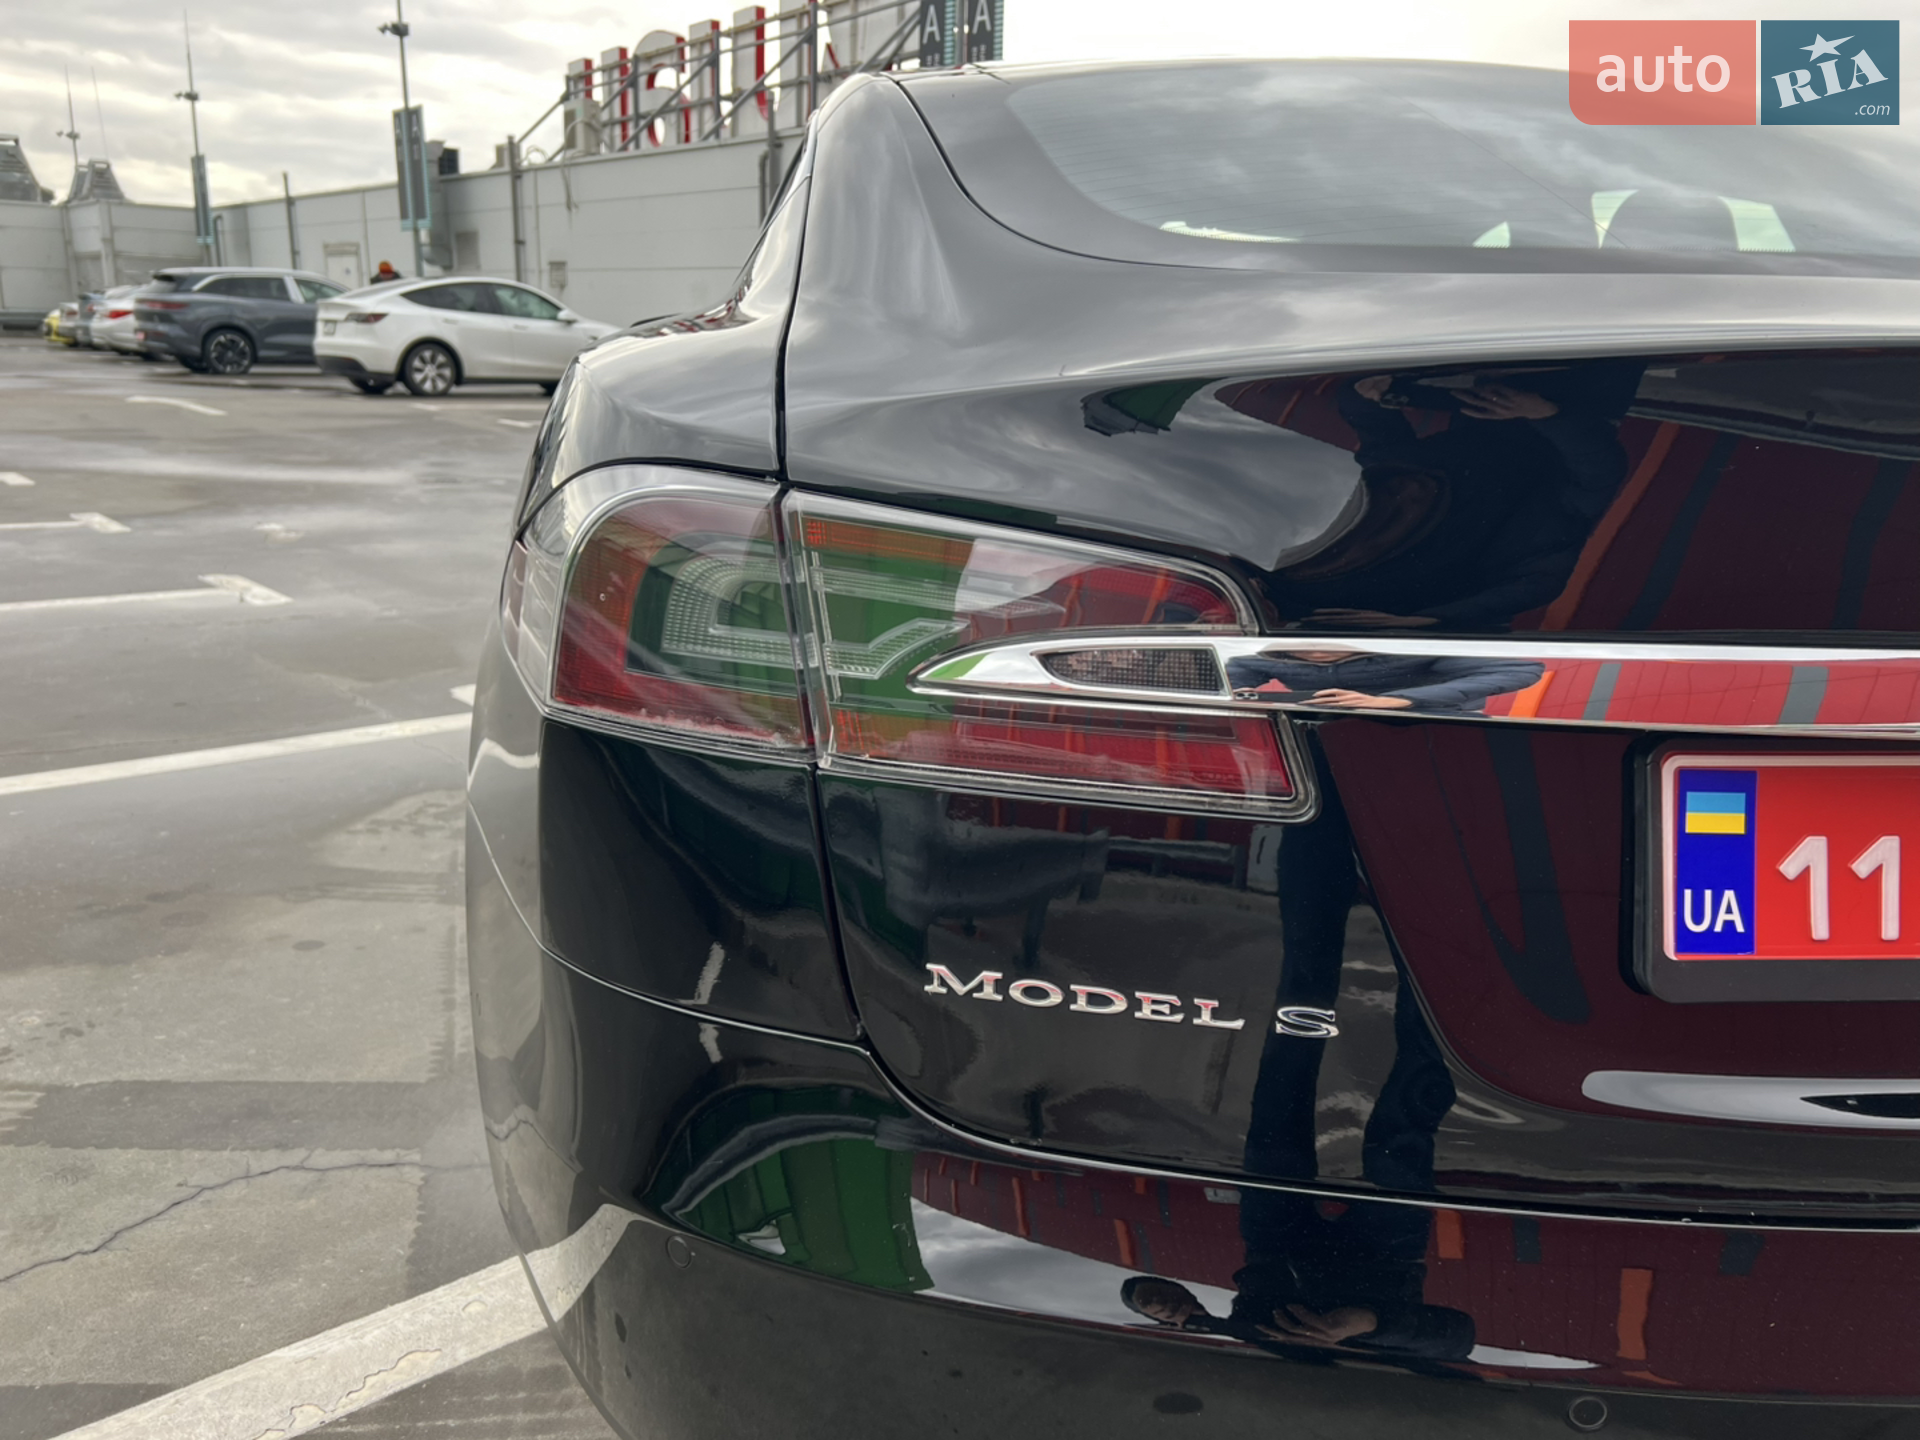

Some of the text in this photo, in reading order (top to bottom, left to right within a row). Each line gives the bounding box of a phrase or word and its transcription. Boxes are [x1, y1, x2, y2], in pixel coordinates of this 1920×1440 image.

[922, 4, 941, 45] A
[1683, 889, 1745, 933] UA
[1778, 835, 1901, 941] 11
[923, 962, 1340, 1039] MODEL S
